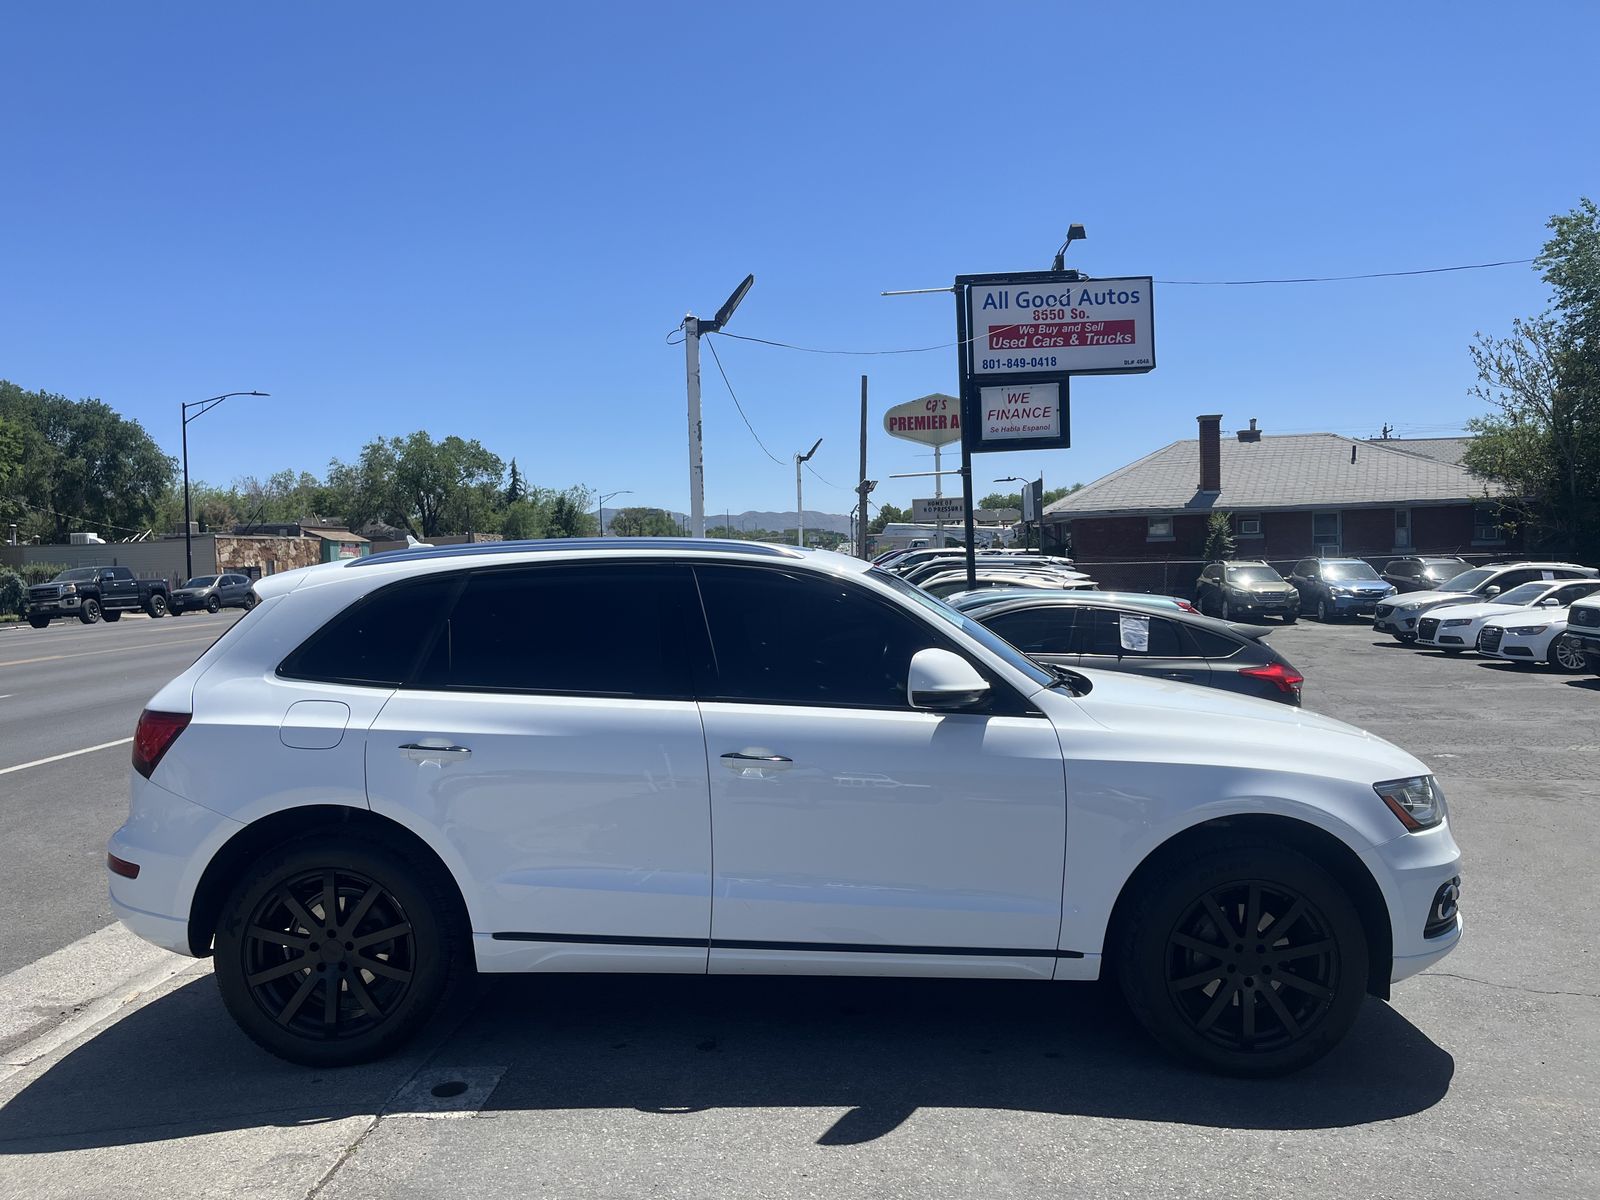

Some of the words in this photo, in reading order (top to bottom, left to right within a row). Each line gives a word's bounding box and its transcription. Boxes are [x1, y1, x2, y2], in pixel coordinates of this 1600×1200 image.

[982, 291, 1008, 310] All
[1016, 289, 1070, 308] Good
[1078, 289, 1140, 306] Autos
[1033, 309, 1064, 321] 8550
[1071, 308, 1090, 319] So.
[1019, 325, 1035, 335] We
[1038, 324, 1059, 335] Buy
[1062, 324, 1081, 333] and
[1085, 322, 1104, 332] Sell
[992, 336, 1027, 348] Used
[1032, 335, 1064, 347] Cars
[1069, 334, 1080, 345] &
[1086, 332, 1132, 344] Trucks
[982, 356, 1057, 370] 801-849-0418
[1007, 392, 1031, 404] WE
[987, 406, 1052, 421] FINANCE
[889, 415, 947, 432] PREMIER
[1000, 425, 1020, 433] Habla
[1022, 424, 1051, 432] Espanol
